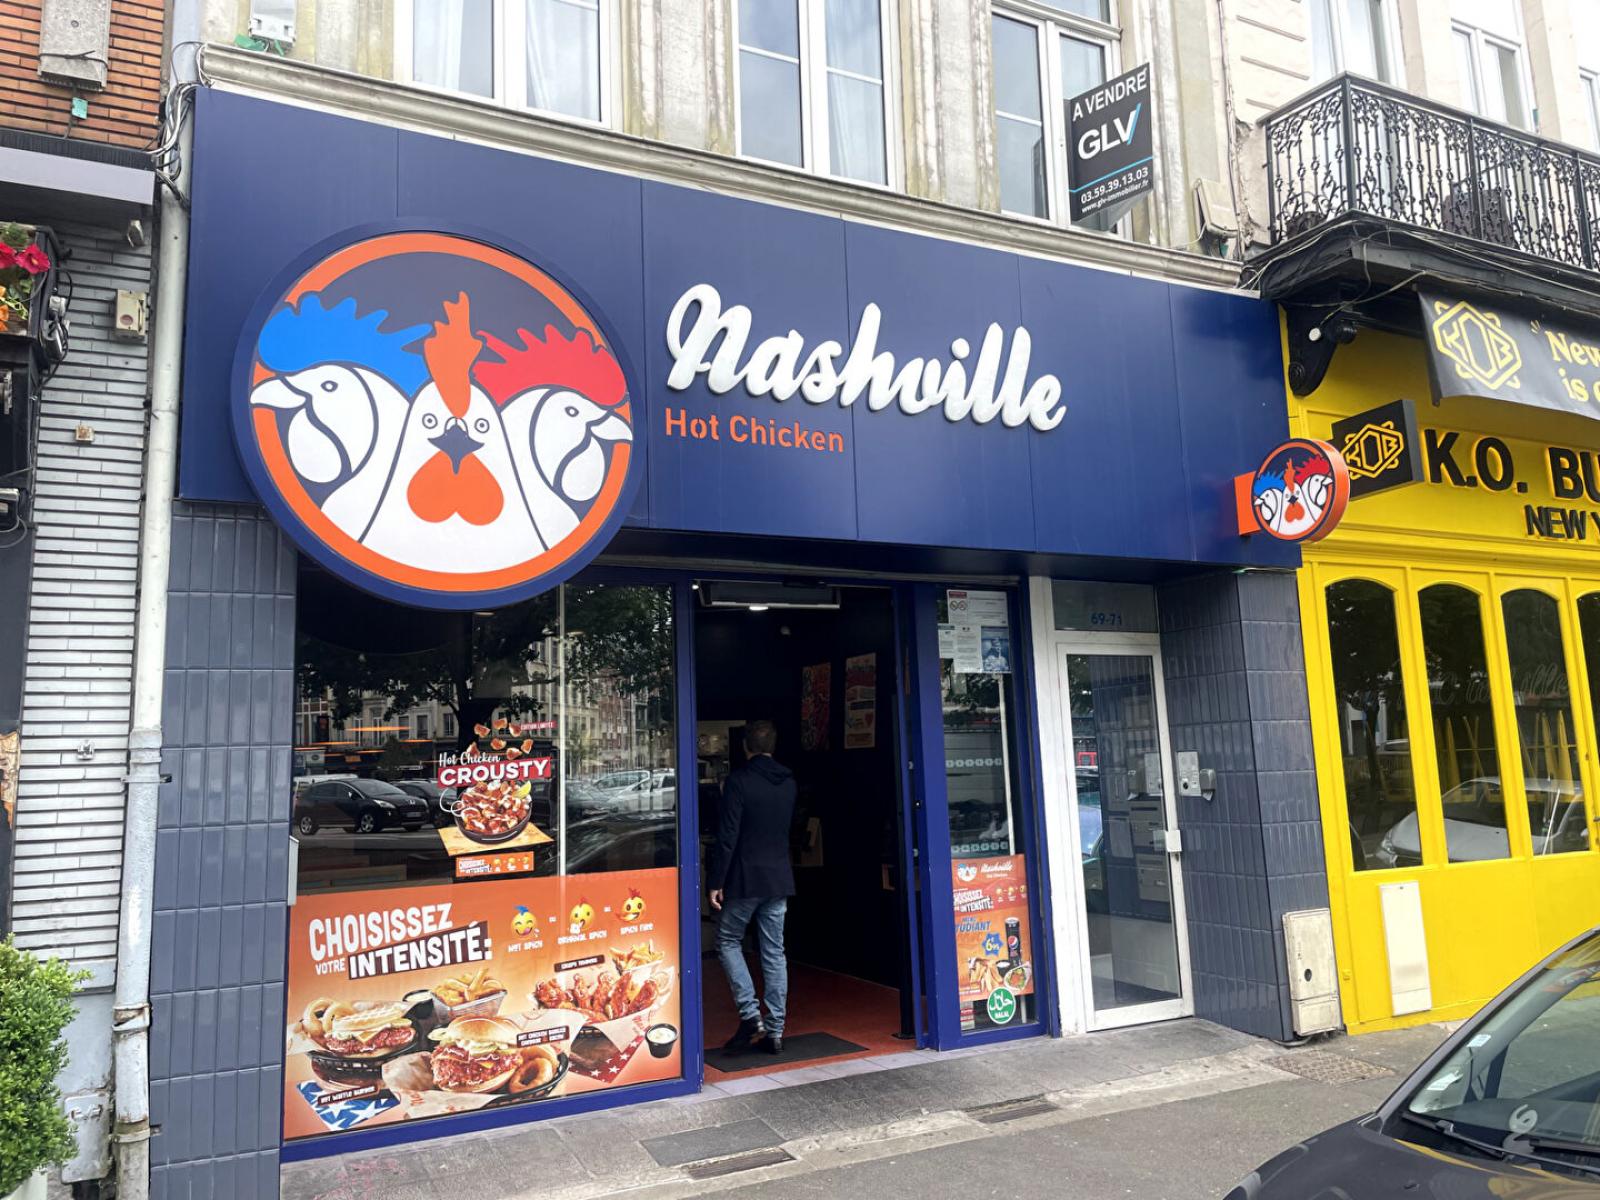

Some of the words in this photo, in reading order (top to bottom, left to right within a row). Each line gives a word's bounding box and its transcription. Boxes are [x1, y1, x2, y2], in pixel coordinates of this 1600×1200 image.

[1072, 102, 1084, 122] A
[1077, 102, 1142, 161] GLV
[1080, 166, 1149, 204] 03.59.39.13.03
[666, 283, 1067, 432] Nashville
[1558, 367, 1590, 403] is
[664, 407, 719, 441] Hot
[729, 415, 845, 454] Chicken
[1423, 428, 1529, 494] K.O.
[1523, 504, 1587, 541] NEW
[1090, 612, 1123, 626] 69-71
[439, 752, 457, 767] Hot
[460, 750, 501, 766] Chicken
[440, 759, 549, 786] CROUSTY
[309, 902, 453, 961] CHOISISSEZ
[350, 920, 493, 979] INTENSITÉ:
[315, 957, 346, 975] VOTRE
